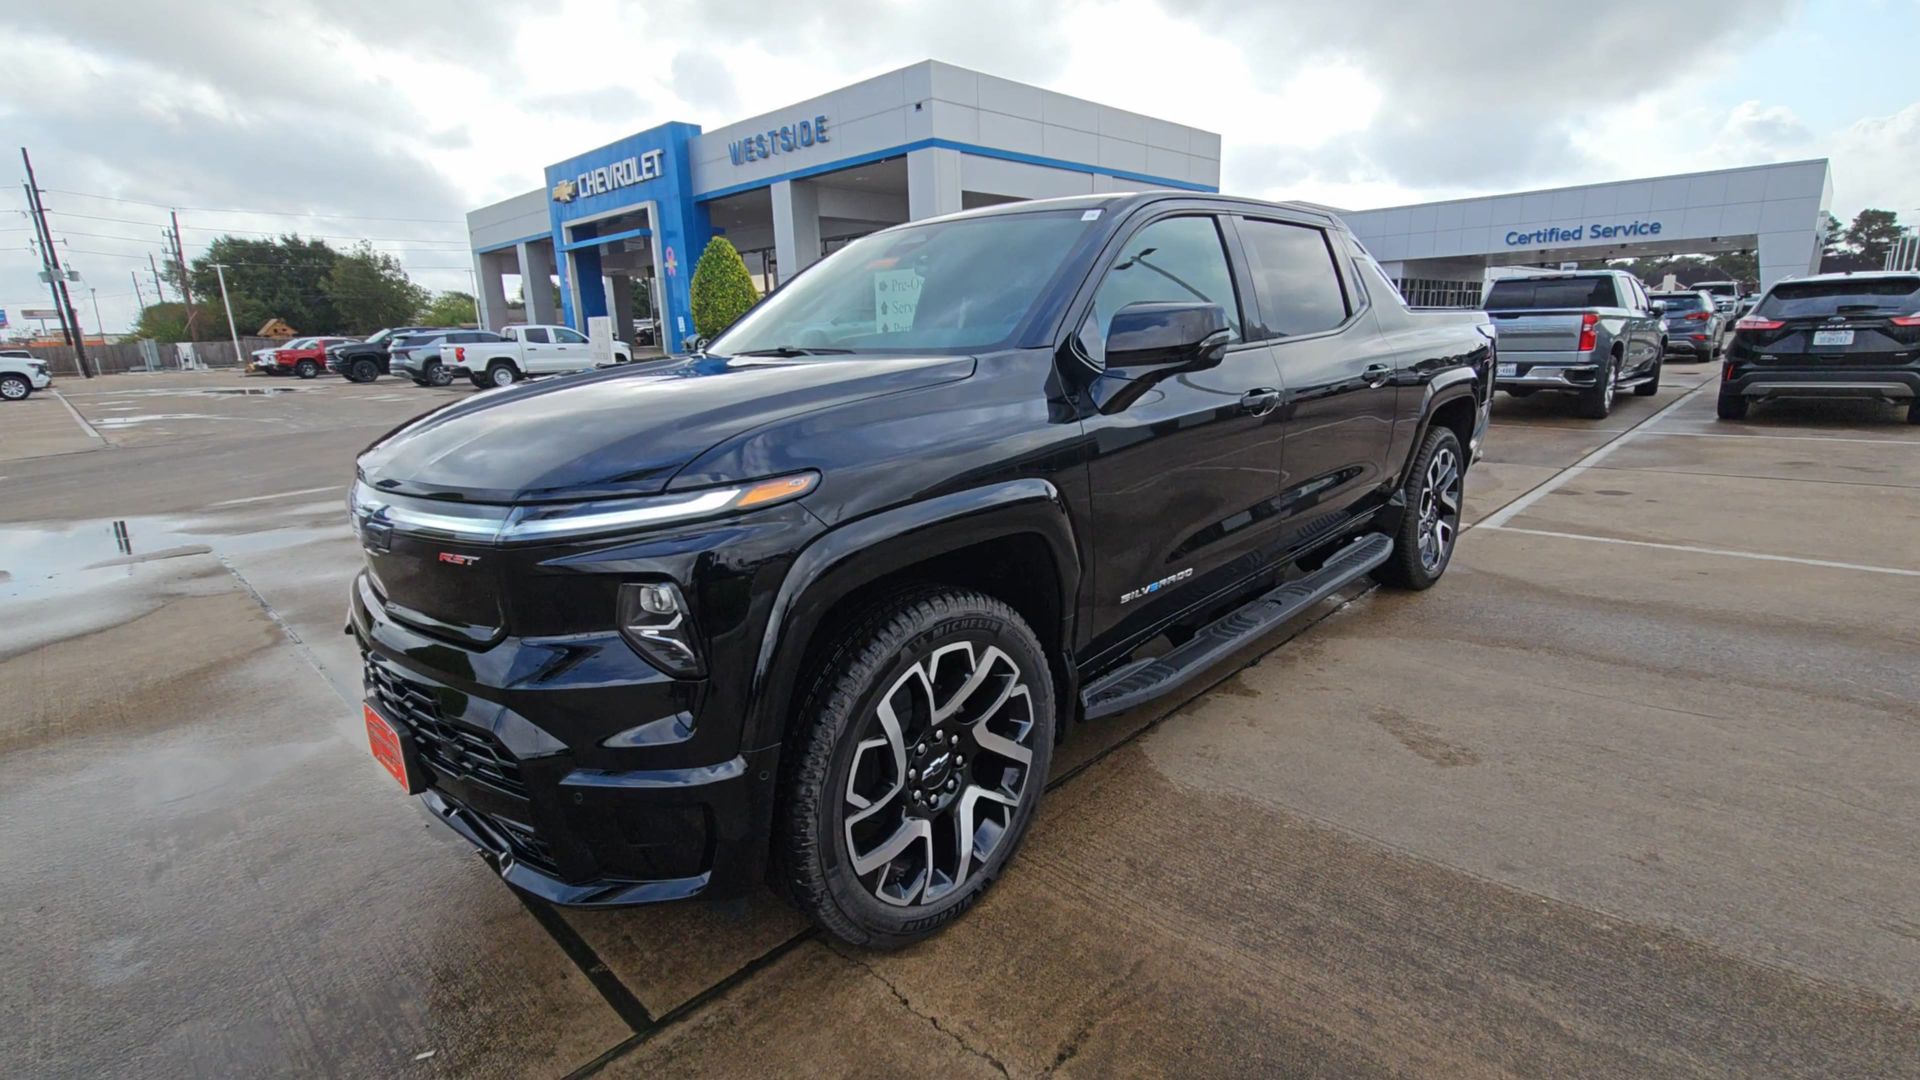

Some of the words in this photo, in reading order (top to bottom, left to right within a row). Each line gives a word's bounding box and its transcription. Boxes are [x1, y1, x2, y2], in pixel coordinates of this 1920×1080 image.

[728, 115, 829, 166] WESTSIDE
[578, 148, 664, 198] CHEVROLET
[1506, 226, 1583, 246] Certified
[1589, 220, 1662, 239] Service
[1120, 567, 1194, 605] SILVERADO
[933, 619, 999, 639] MICHELIN
